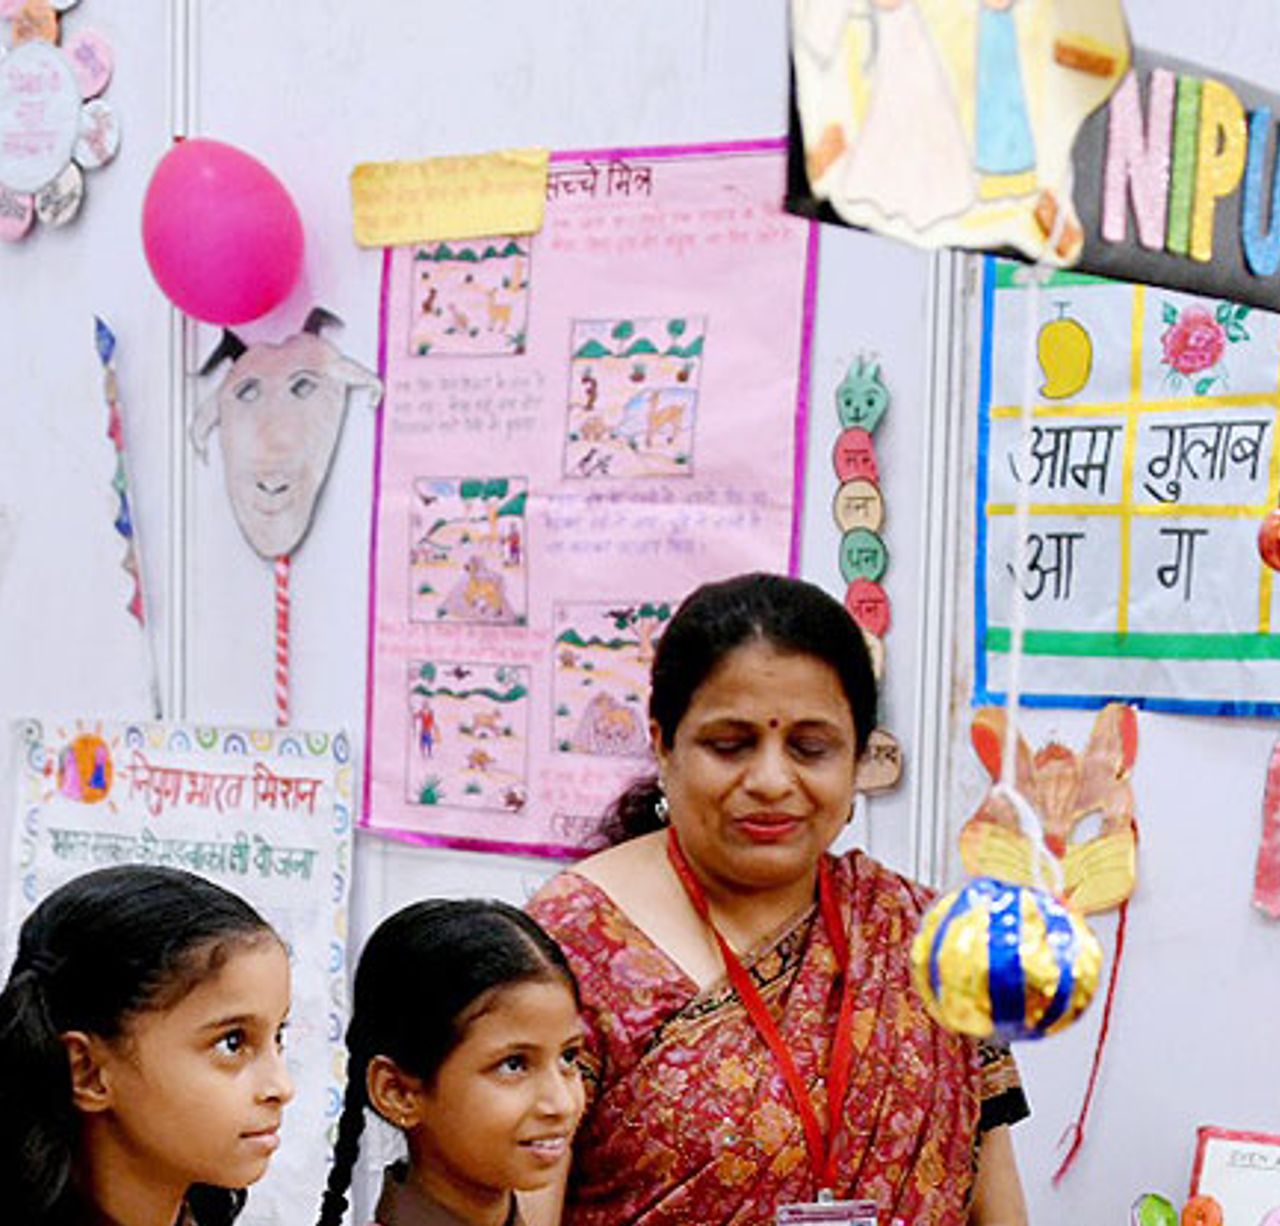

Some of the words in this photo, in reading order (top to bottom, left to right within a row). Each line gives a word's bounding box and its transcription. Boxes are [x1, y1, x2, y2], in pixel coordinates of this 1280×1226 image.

[1009, 427, 1122, 494] आम
[1144, 420, 1271, 503] गुलाब
[1007, 533, 1085, 600] आ
[1157, 528, 1209, 600] ग
